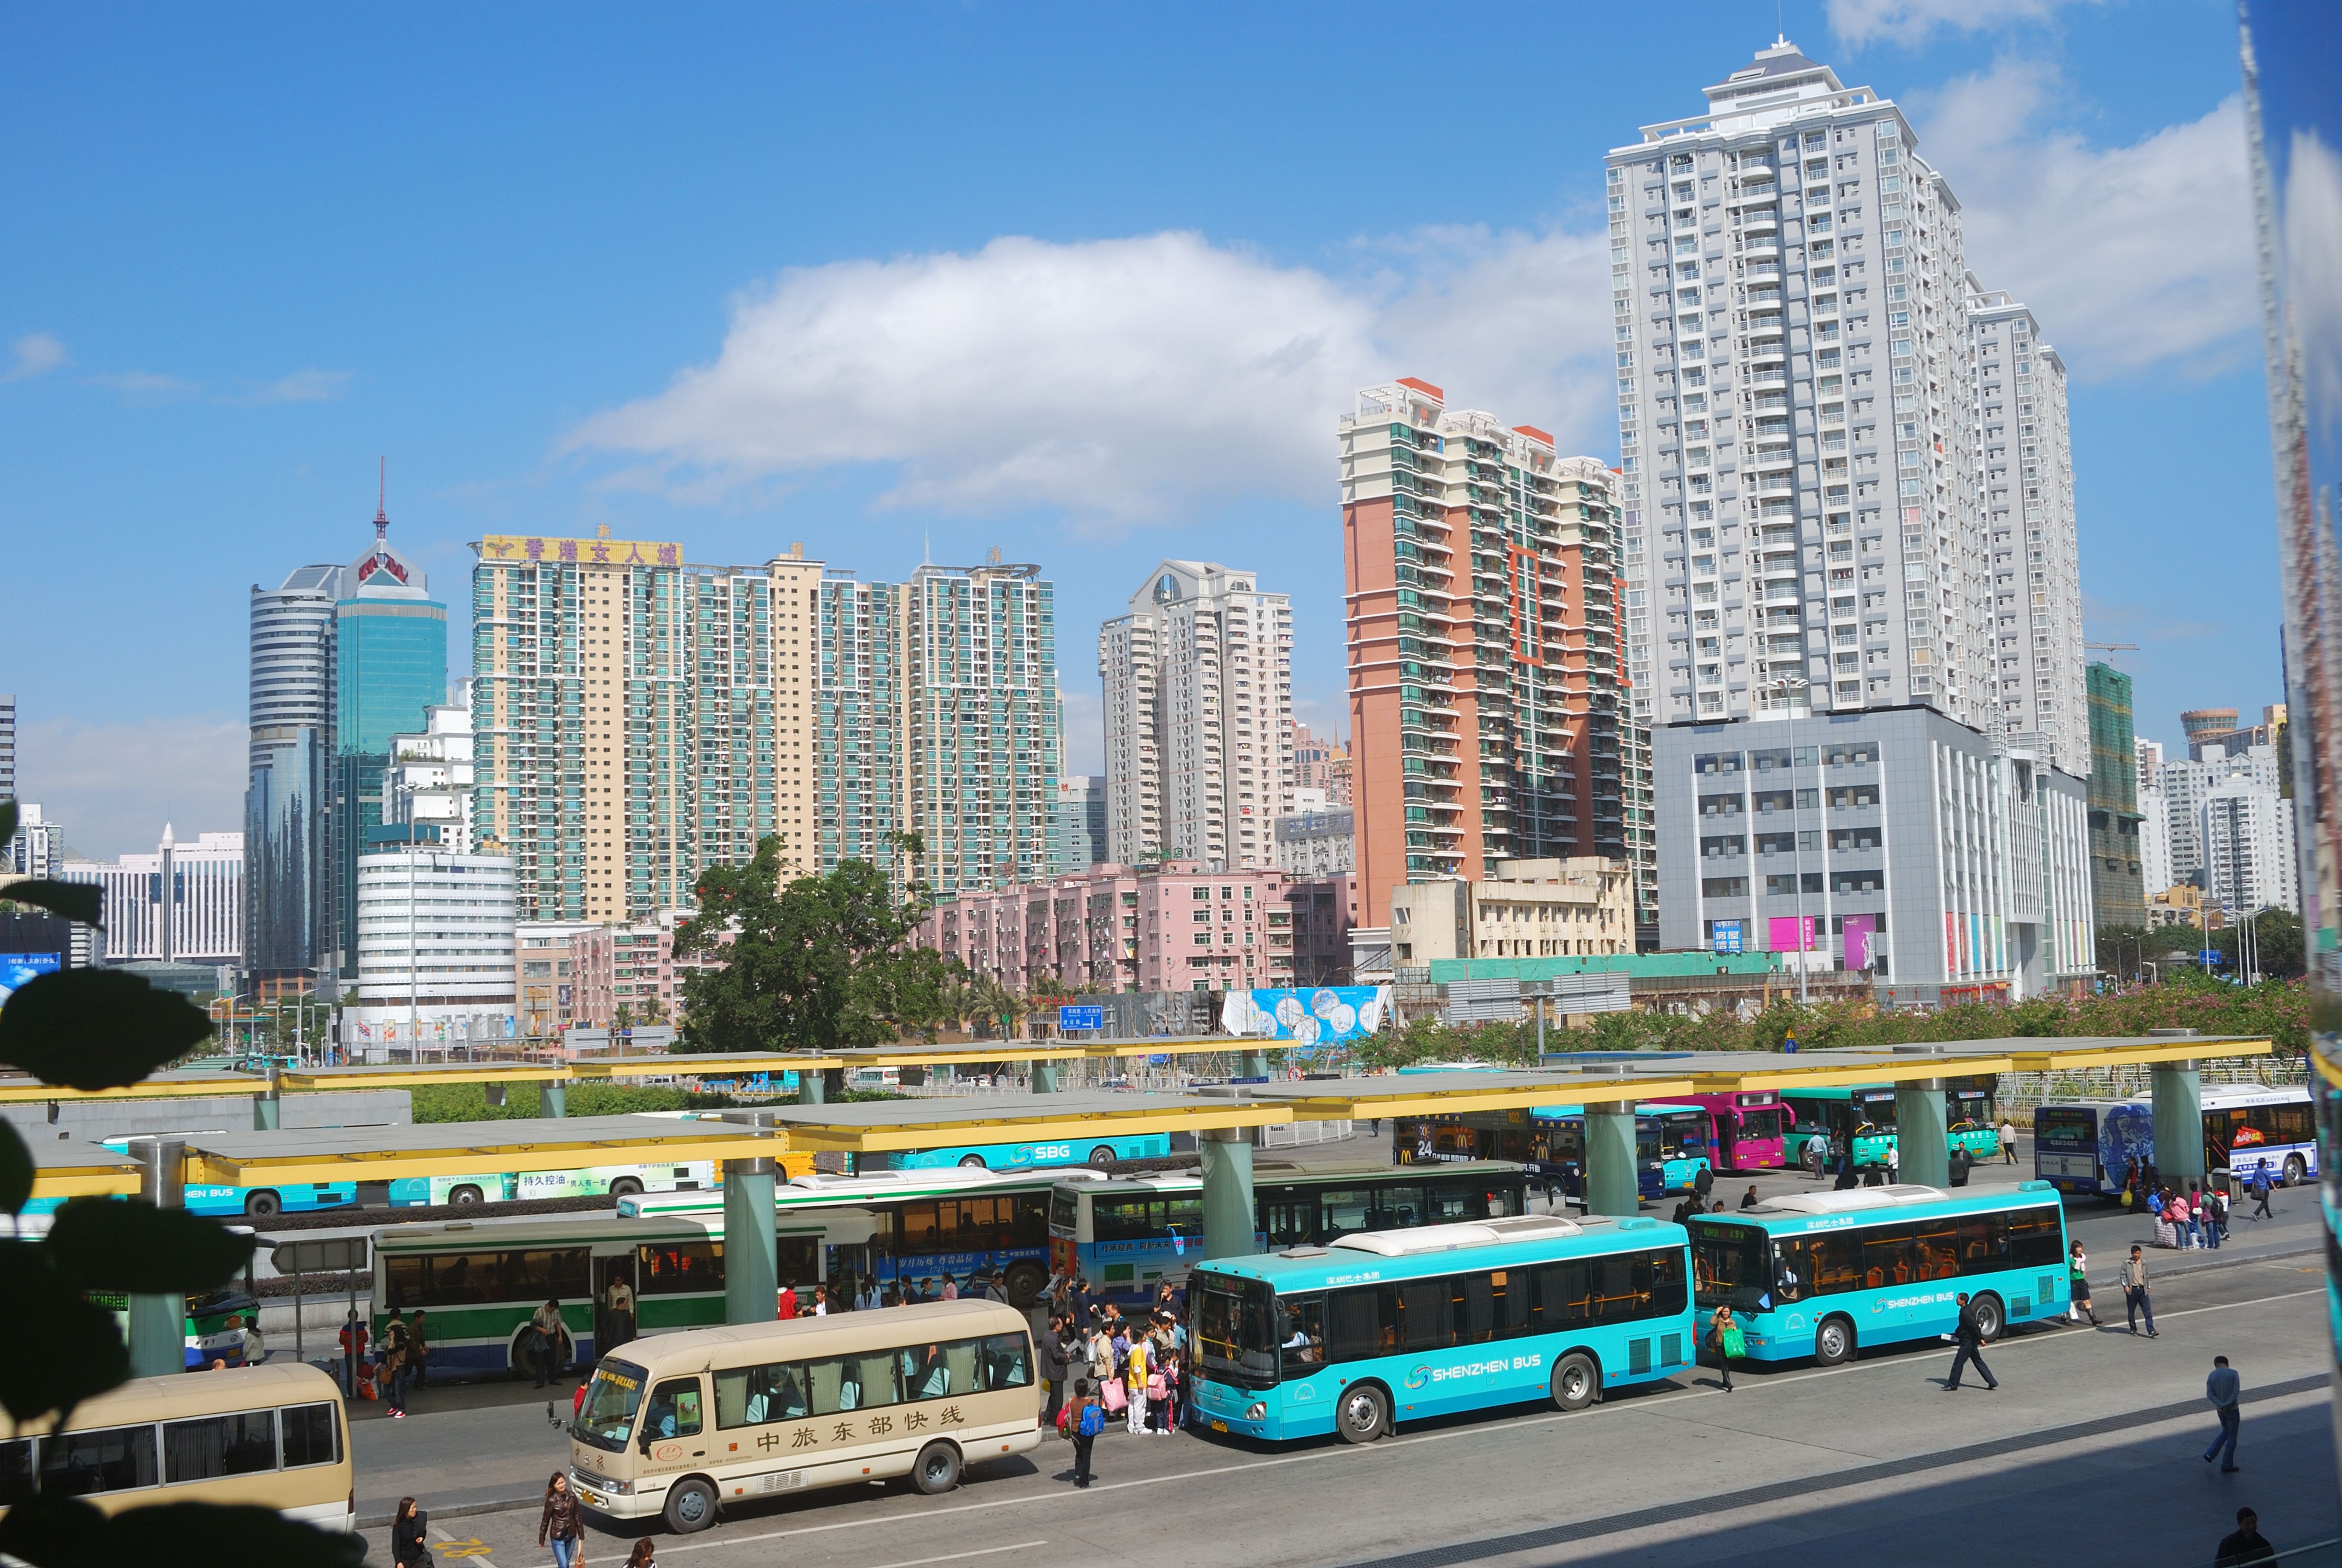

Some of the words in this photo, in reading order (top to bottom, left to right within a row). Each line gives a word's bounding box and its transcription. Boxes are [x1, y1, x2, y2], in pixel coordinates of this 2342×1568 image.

[525, 538, 677, 564] 香港女人城
[1035, 1145, 1070, 1159] SBG
[1418, 1140, 1432, 1156] 24
[210, 1188, 234, 1197] BUS
[1806, 1217, 1854, 1229] 深圳巴士集团
[1102, 1243, 1134, 1253] 传承经典
[1139, 1240, 1172, 1250] 刷新未来
[939, 1254, 974, 1265] 尊贵品位
[1327, 1271, 1380, 1285] 深圳巴士集团
[1888, 1295, 1934, 1309] SHENZHEN
[1936, 1292, 1954, 1302] BUS
[1433, 1359, 1509, 1382] SHENZHEN
[1513, 1354, 1541, 1369] BUS
[756, 1405, 964, 1453] 中旅东部快线
